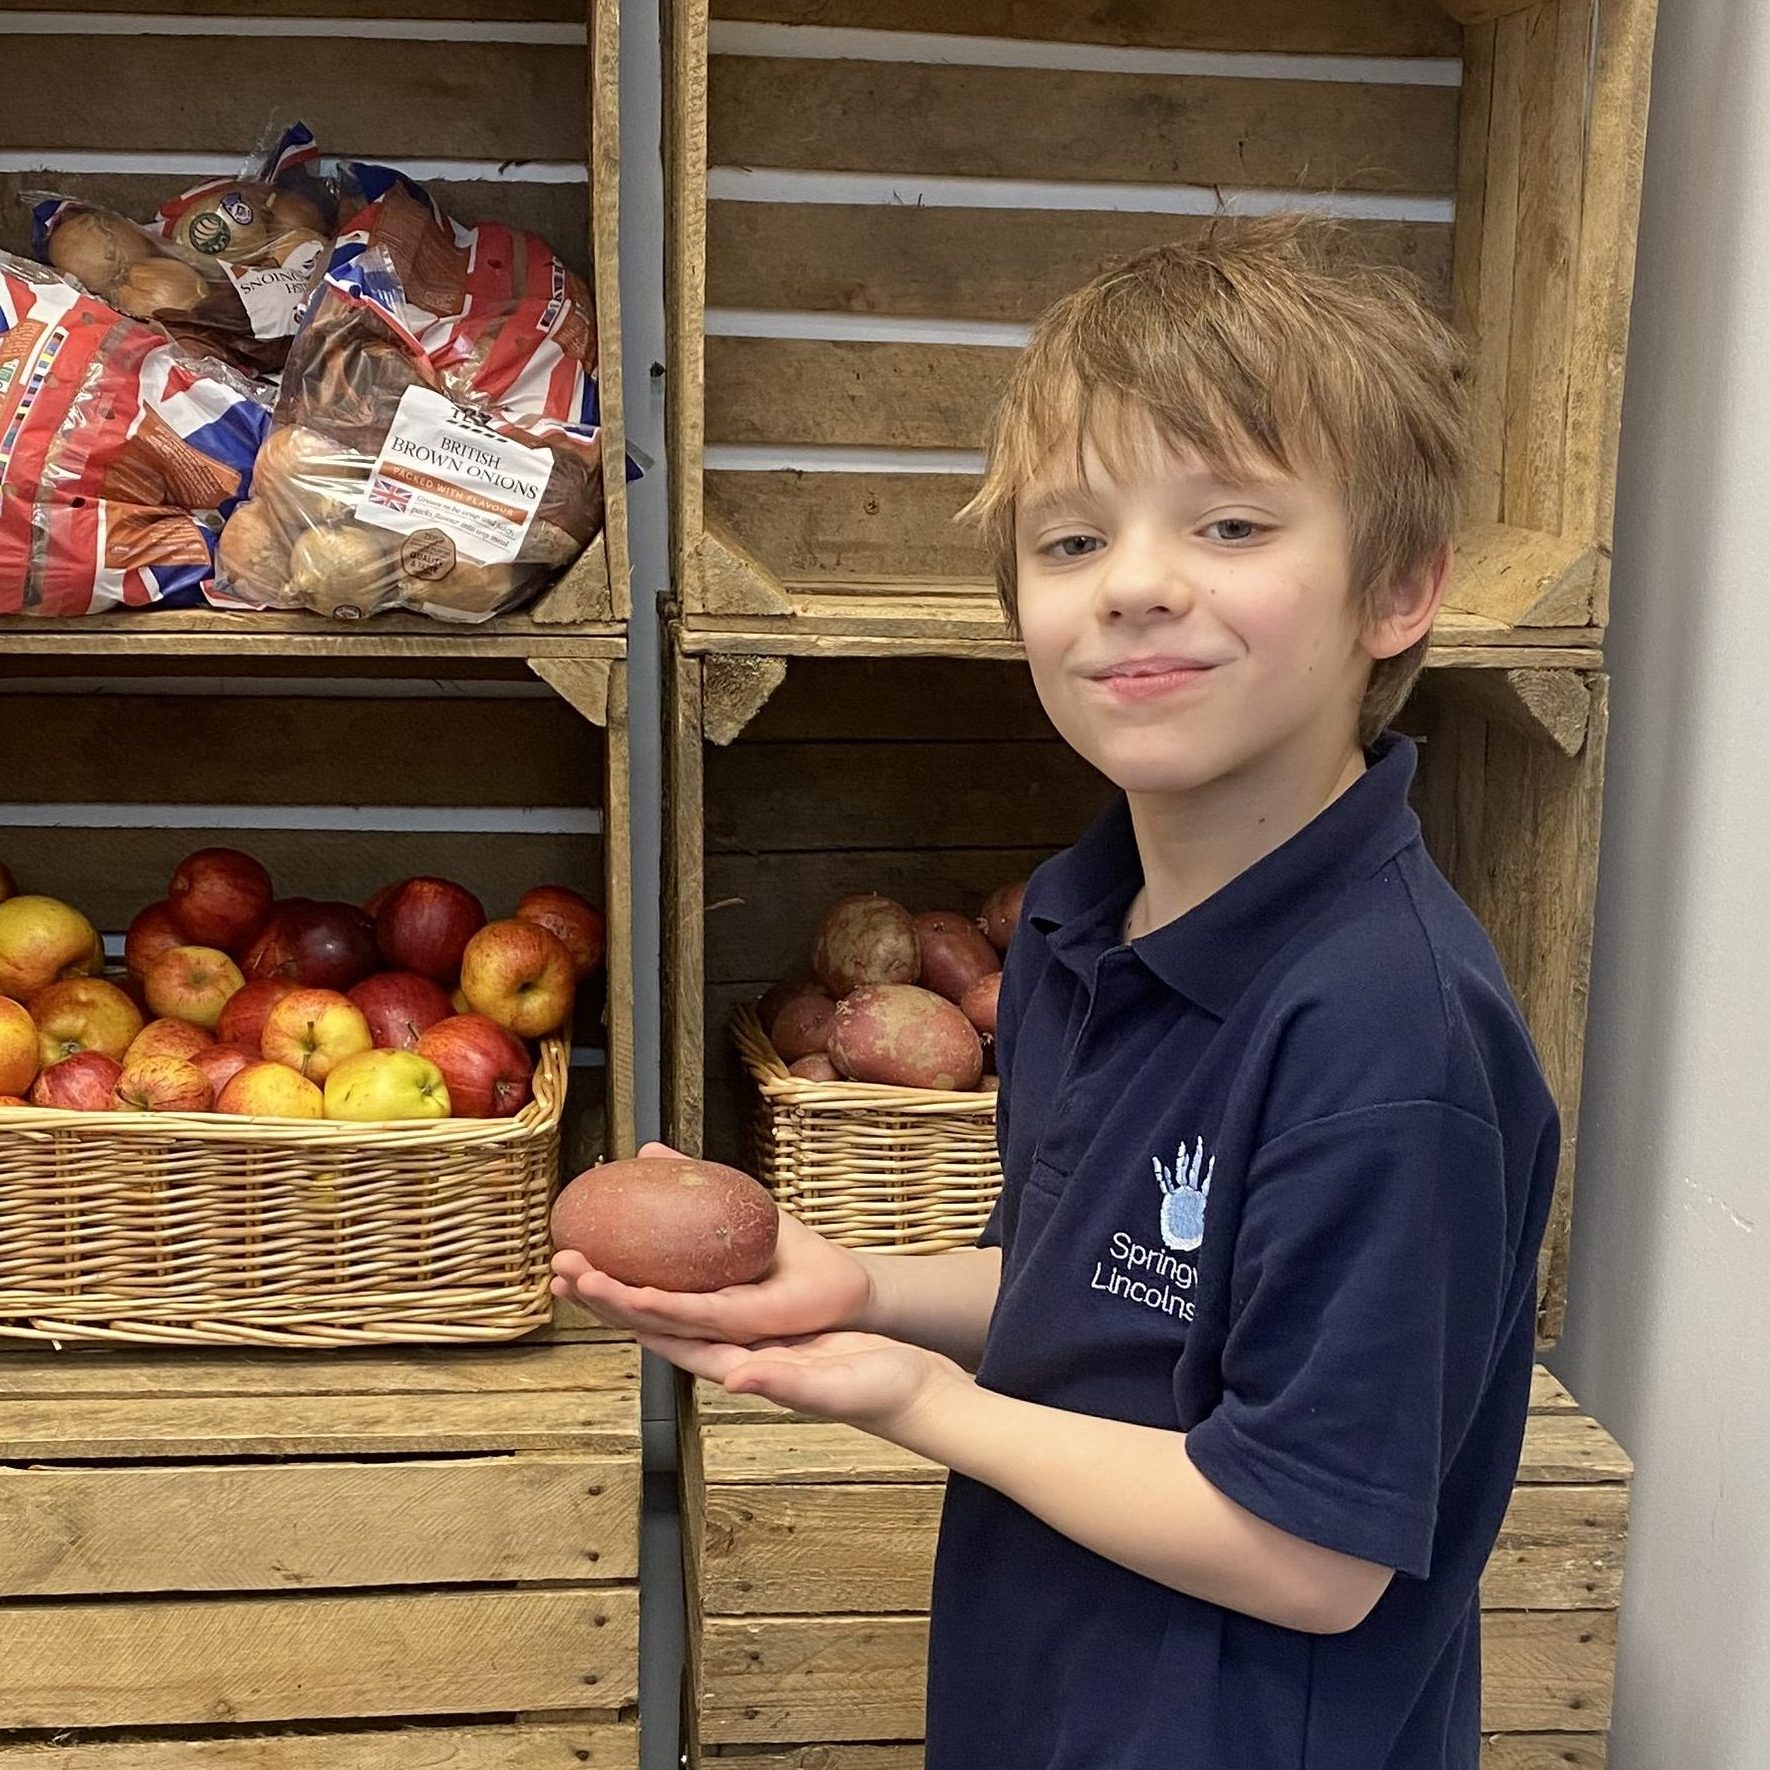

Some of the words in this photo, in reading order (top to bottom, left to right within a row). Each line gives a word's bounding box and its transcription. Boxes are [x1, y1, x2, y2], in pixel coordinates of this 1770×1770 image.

[391, 437, 463, 472] BROWN
[467, 464, 538, 500] ONIONS
[440, 437, 501, 469] BRITISH
[392, 467, 433, 488] PACKED
[437, 483, 463, 500] WITH
[466, 495, 514, 515] FLAVOUR
